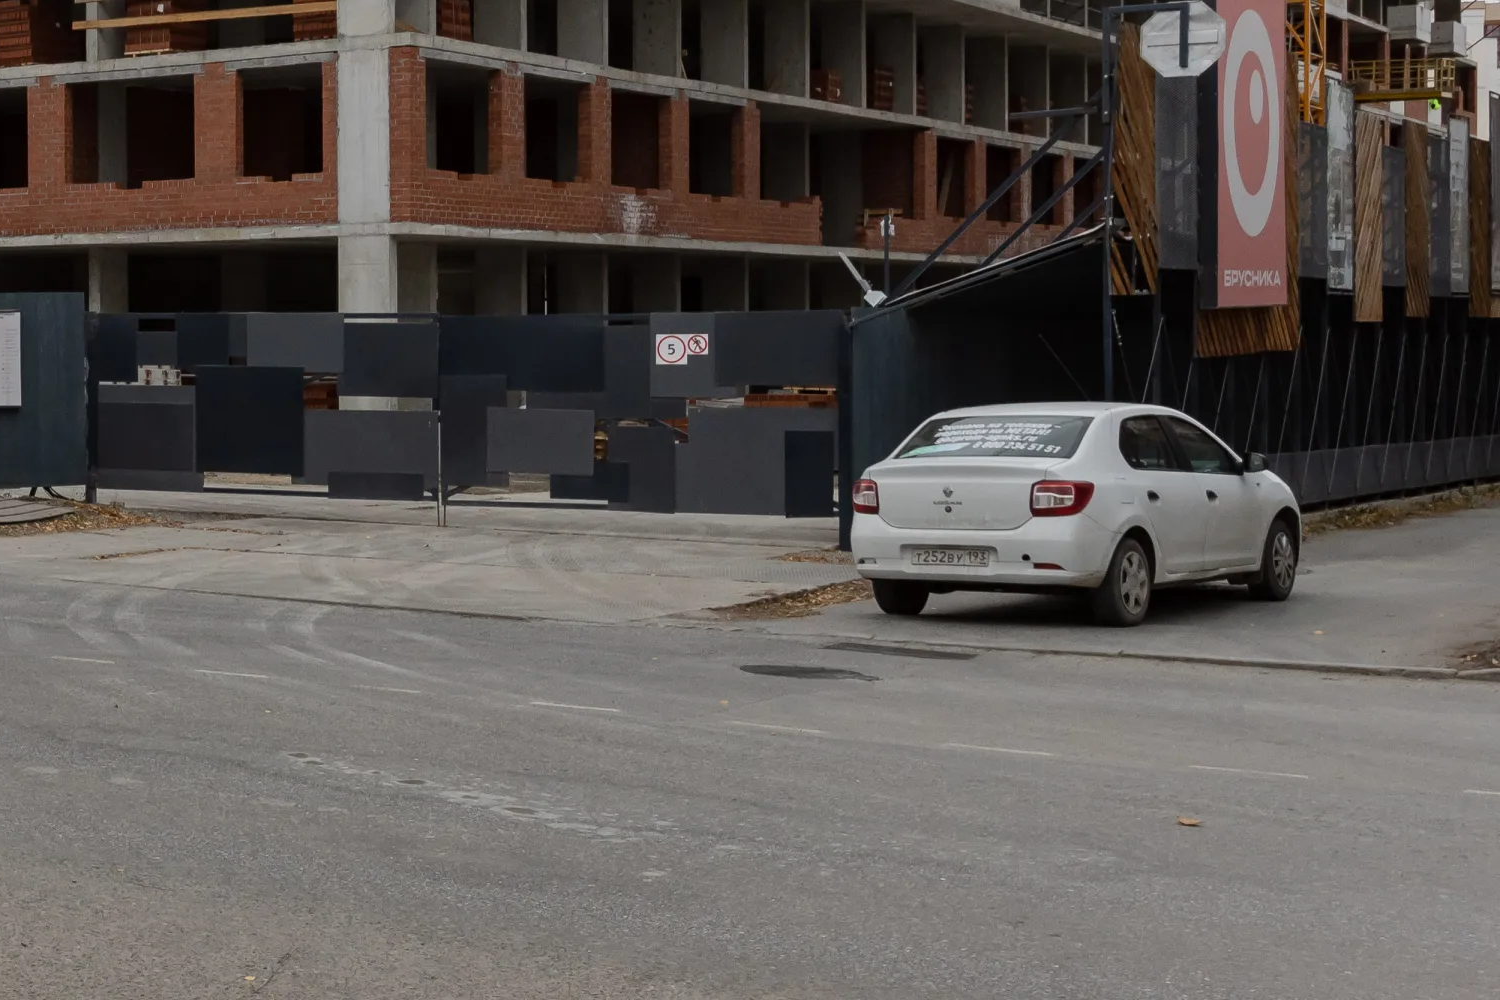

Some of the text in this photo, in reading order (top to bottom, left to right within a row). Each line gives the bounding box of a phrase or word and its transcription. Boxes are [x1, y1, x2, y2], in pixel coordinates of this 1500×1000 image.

[1223, 269, 1281, 287] БРУСНИКА
[667, 343, 676, 356] 5
[1004, 441, 1028, 449] 234
[1026, 442, 1045, 452] 51
[1043, 444, 1062, 454] 51
